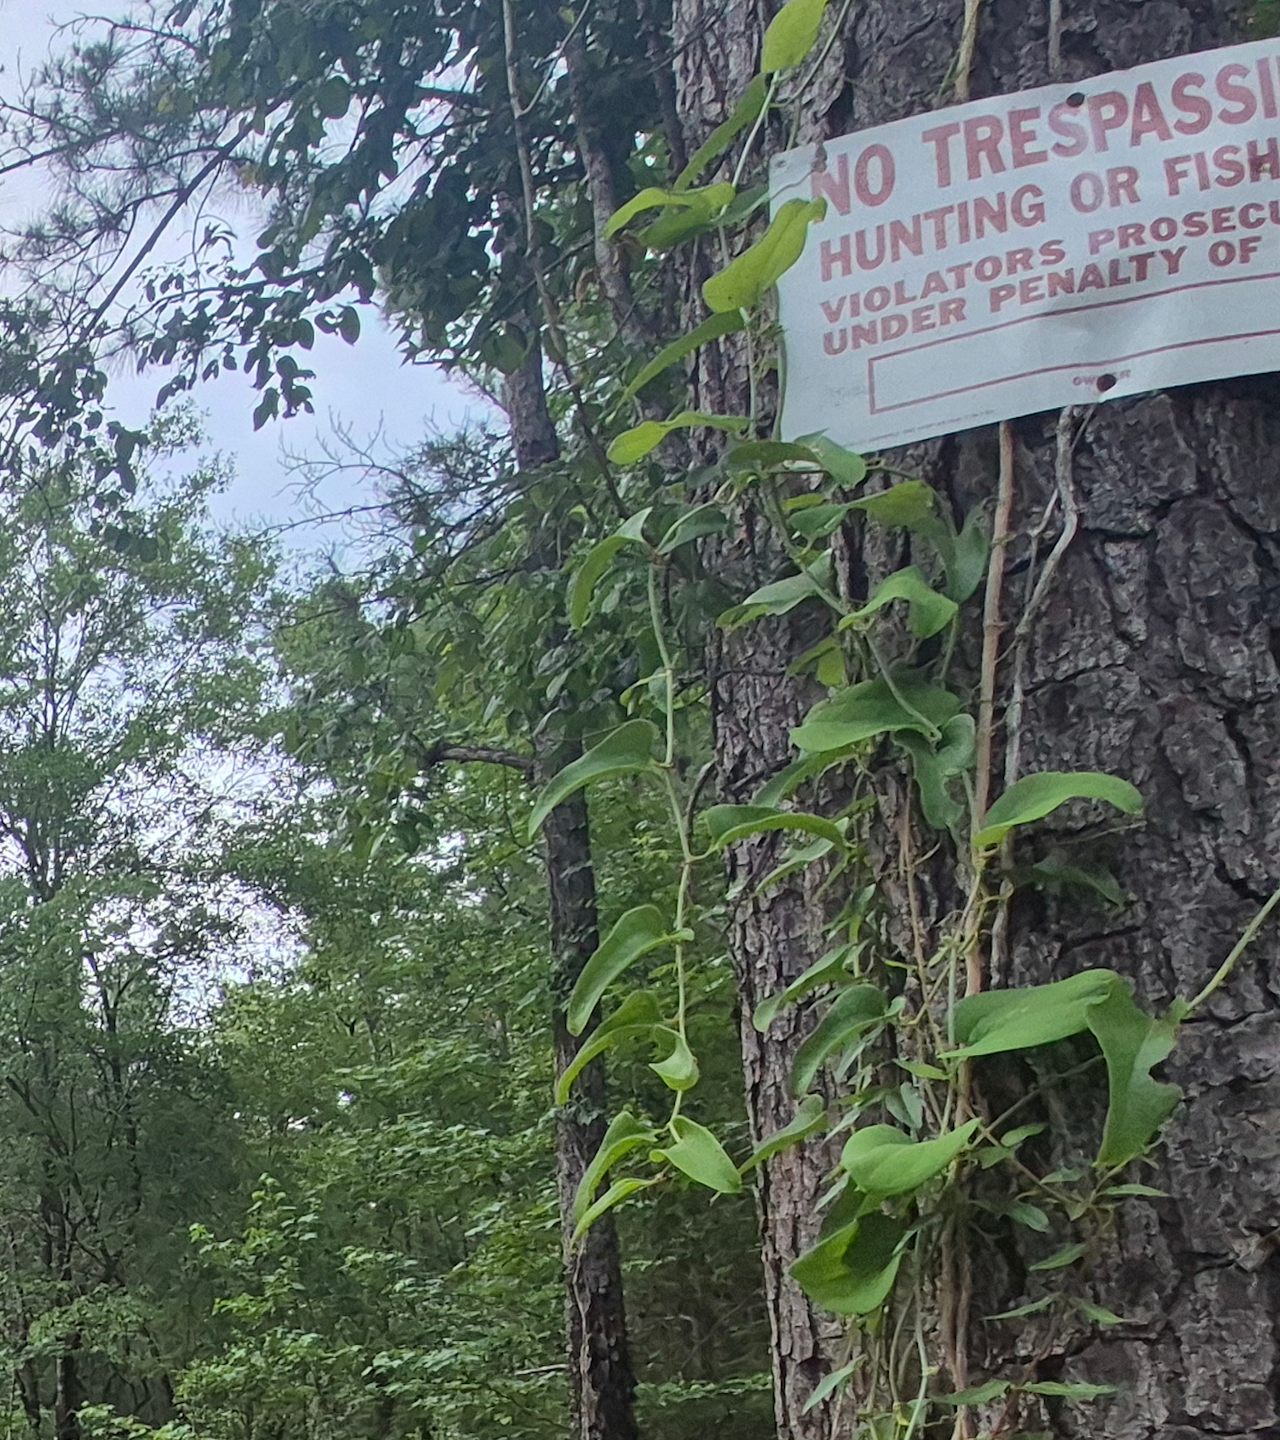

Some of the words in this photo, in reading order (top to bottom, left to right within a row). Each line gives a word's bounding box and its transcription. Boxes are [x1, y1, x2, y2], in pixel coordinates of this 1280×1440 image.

[810, 143, 896, 221] NO
[922, 56, 1280, 188] TRESPASSI
[819, 184, 1046, 282] HUNTING
[1070, 165, 1142, 213] OR
[1163, 136, 1280, 197] FISH
[820, 239, 1066, 323] VIOLATORS
[823, 297, 967, 356] UNDER
[989, 245, 1186, 313] PENALTY
[1207, 235, 1262, 267] OF
